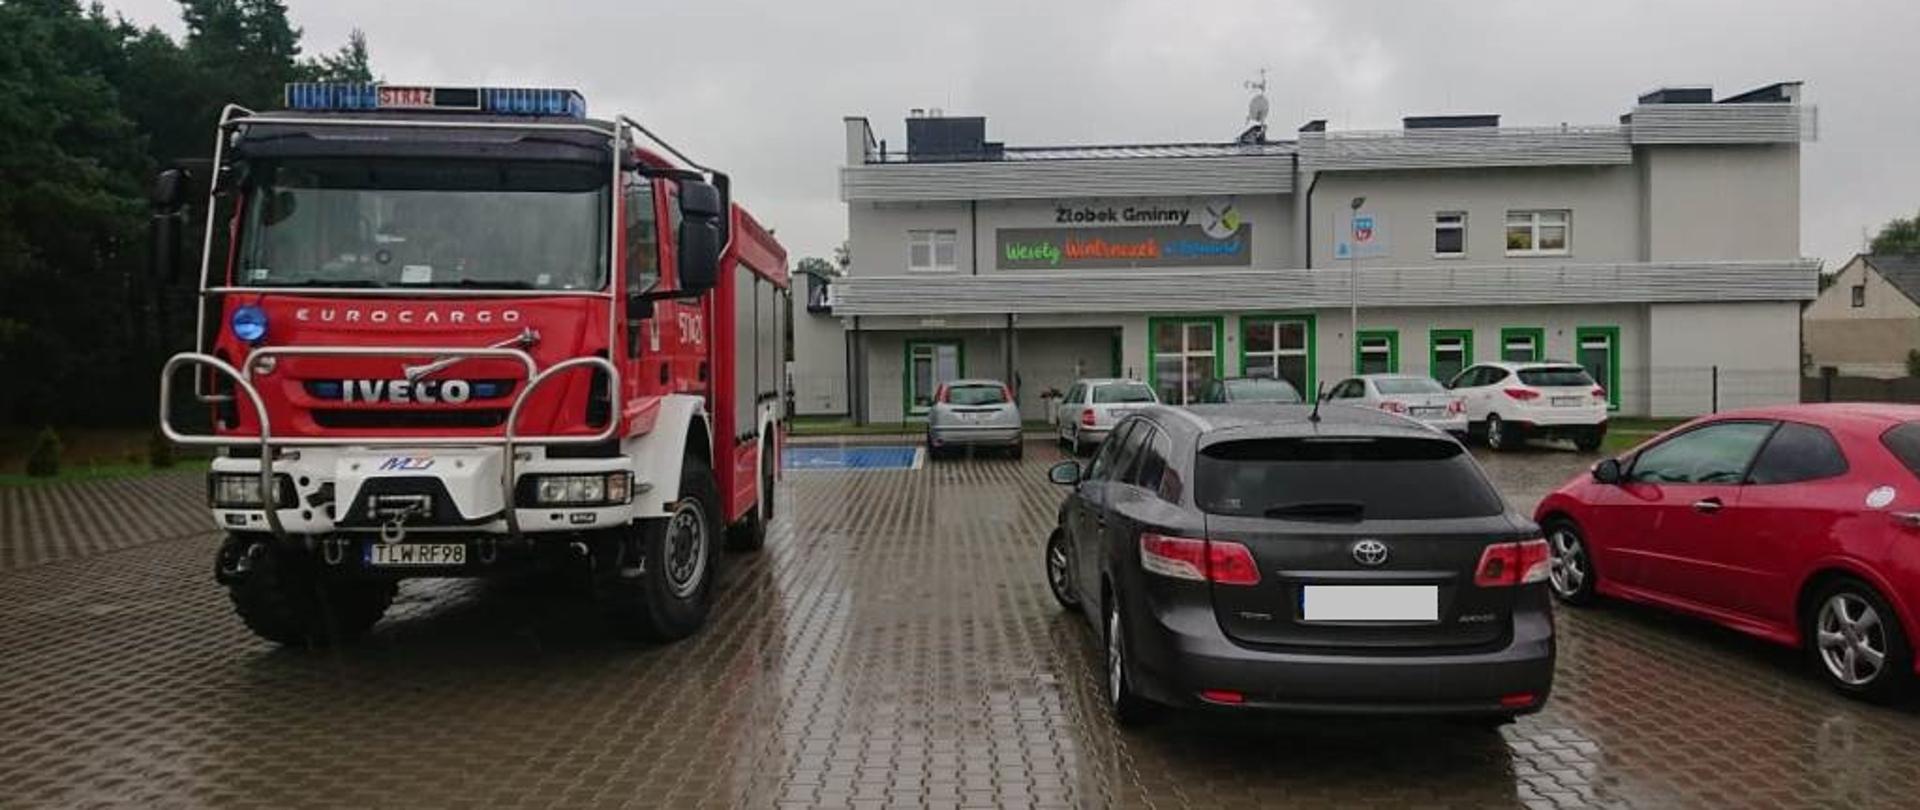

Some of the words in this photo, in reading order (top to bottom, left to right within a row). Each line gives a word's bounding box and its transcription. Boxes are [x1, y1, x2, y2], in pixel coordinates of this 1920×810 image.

[1123, 206, 1190, 225] Gminny
[296, 308, 520, 323] EUROCARGO
[342, 379, 470, 404] IVECO
[375, 545, 414, 562] TLW
[419, 545, 463, 562] RF98
